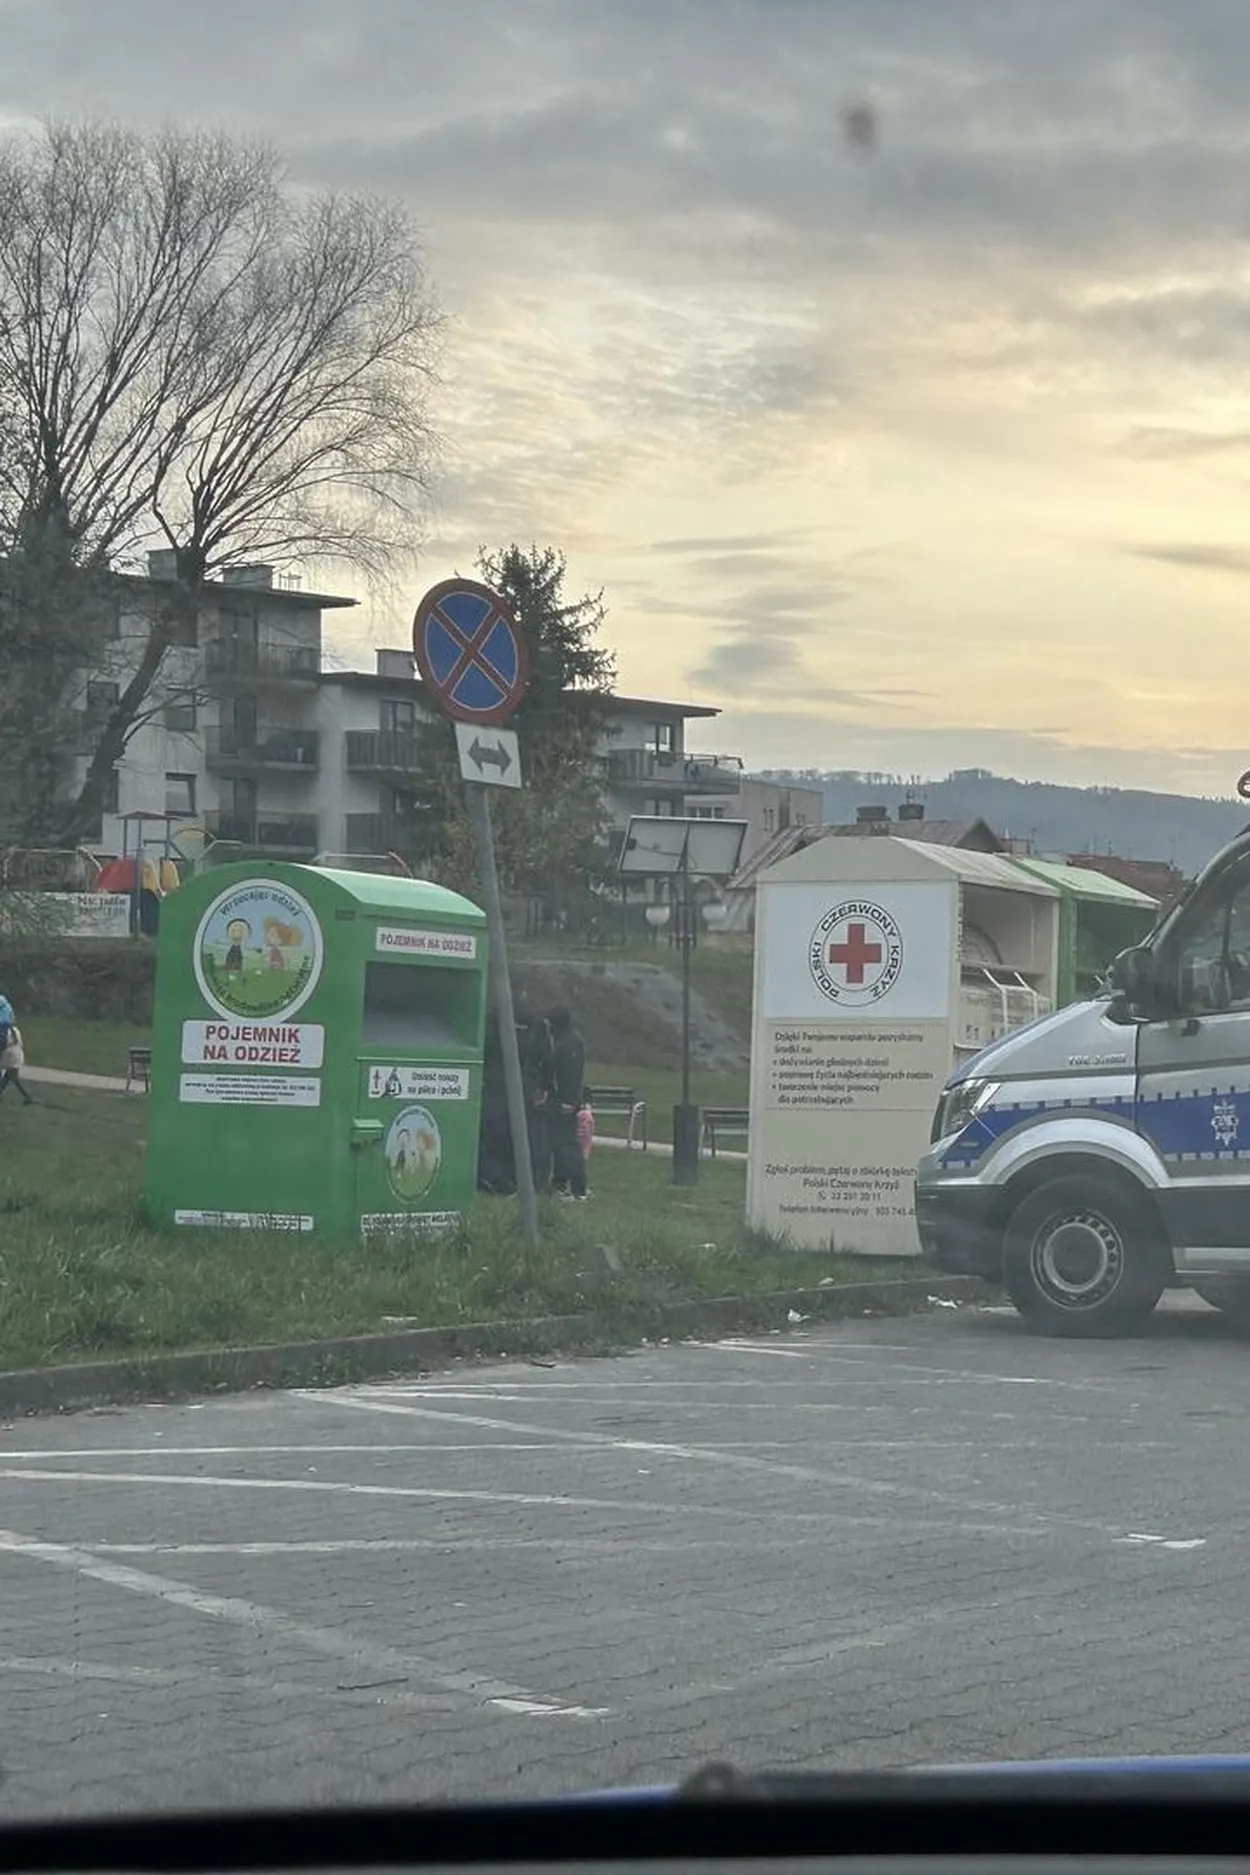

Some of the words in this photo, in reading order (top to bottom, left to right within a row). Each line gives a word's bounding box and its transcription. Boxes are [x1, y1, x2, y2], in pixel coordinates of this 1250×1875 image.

[820, 903, 897, 937] CZERWONY
[380, 933, 425, 949] POJEMNIK
[427, 937, 441, 949] NA
[812, 941, 840, 998] POLSKI
[205, 1025, 301, 1043] POJEMNIK
[203, 1045, 228, 1060] NA
[234, 1045, 301, 1063] ODZIEŻ
[815, 1070, 836, 1081] życia
[802, 1178, 829, 1190] Polski
[829, 1178, 873, 1191] Czerwony
